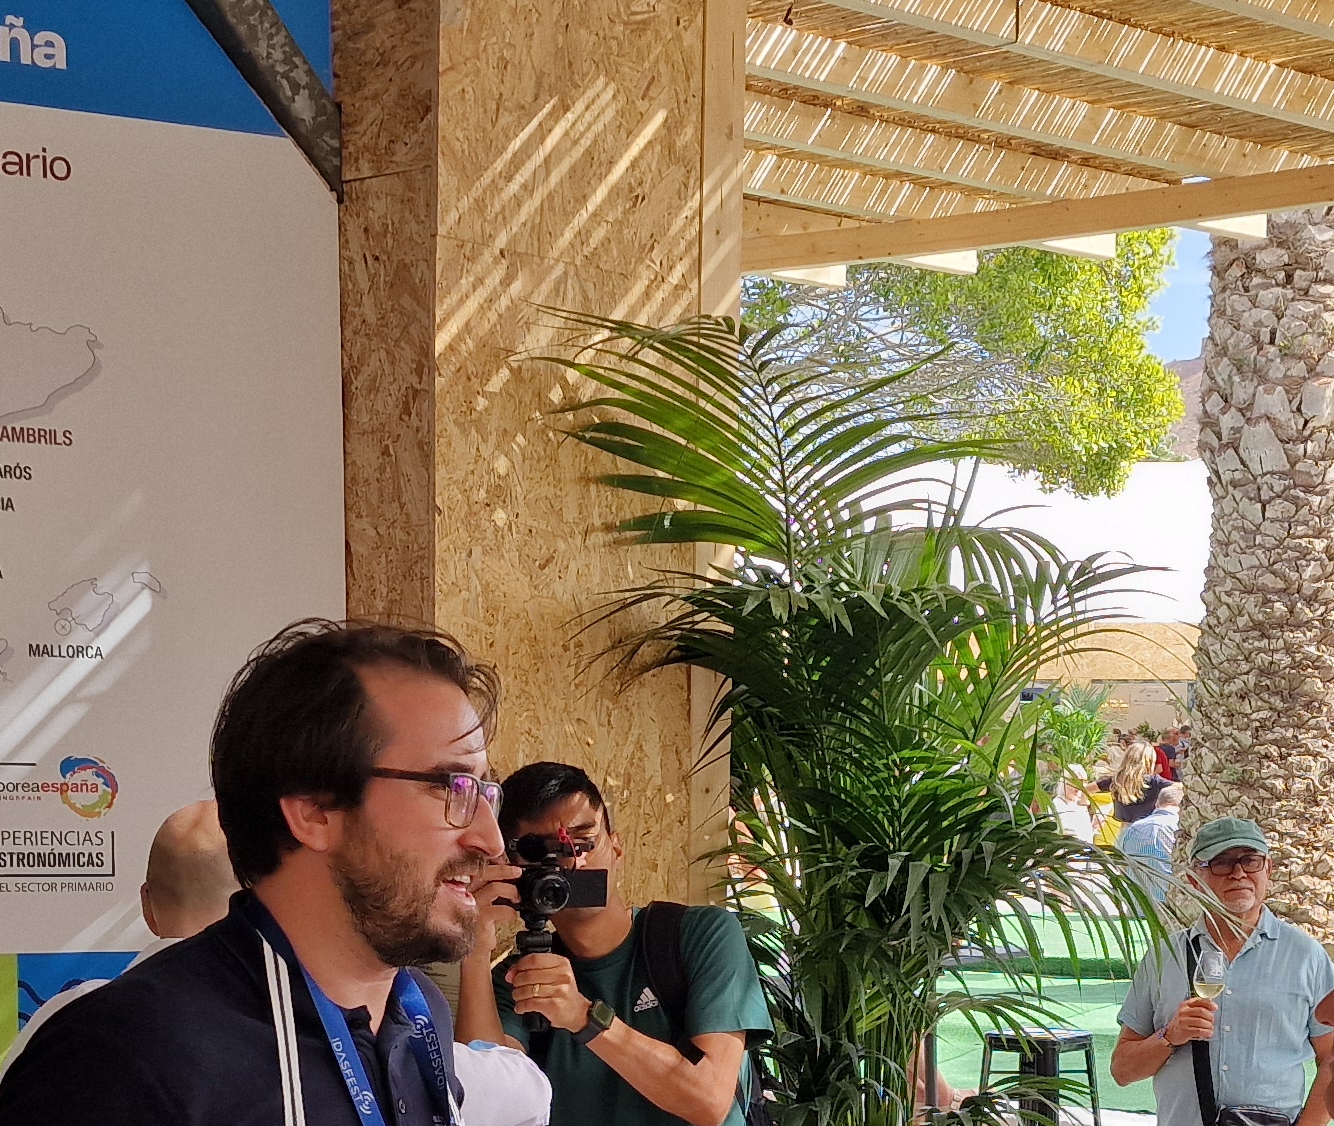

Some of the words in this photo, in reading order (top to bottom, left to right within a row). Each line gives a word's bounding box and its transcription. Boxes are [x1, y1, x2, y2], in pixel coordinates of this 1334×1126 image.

[29, 644, 104, 659] MALLORCA
[0, 883, 11, 892] EL
[15, 883, 57, 892] SECTOR
[61, 882, 113, 892] PRIMARIO
